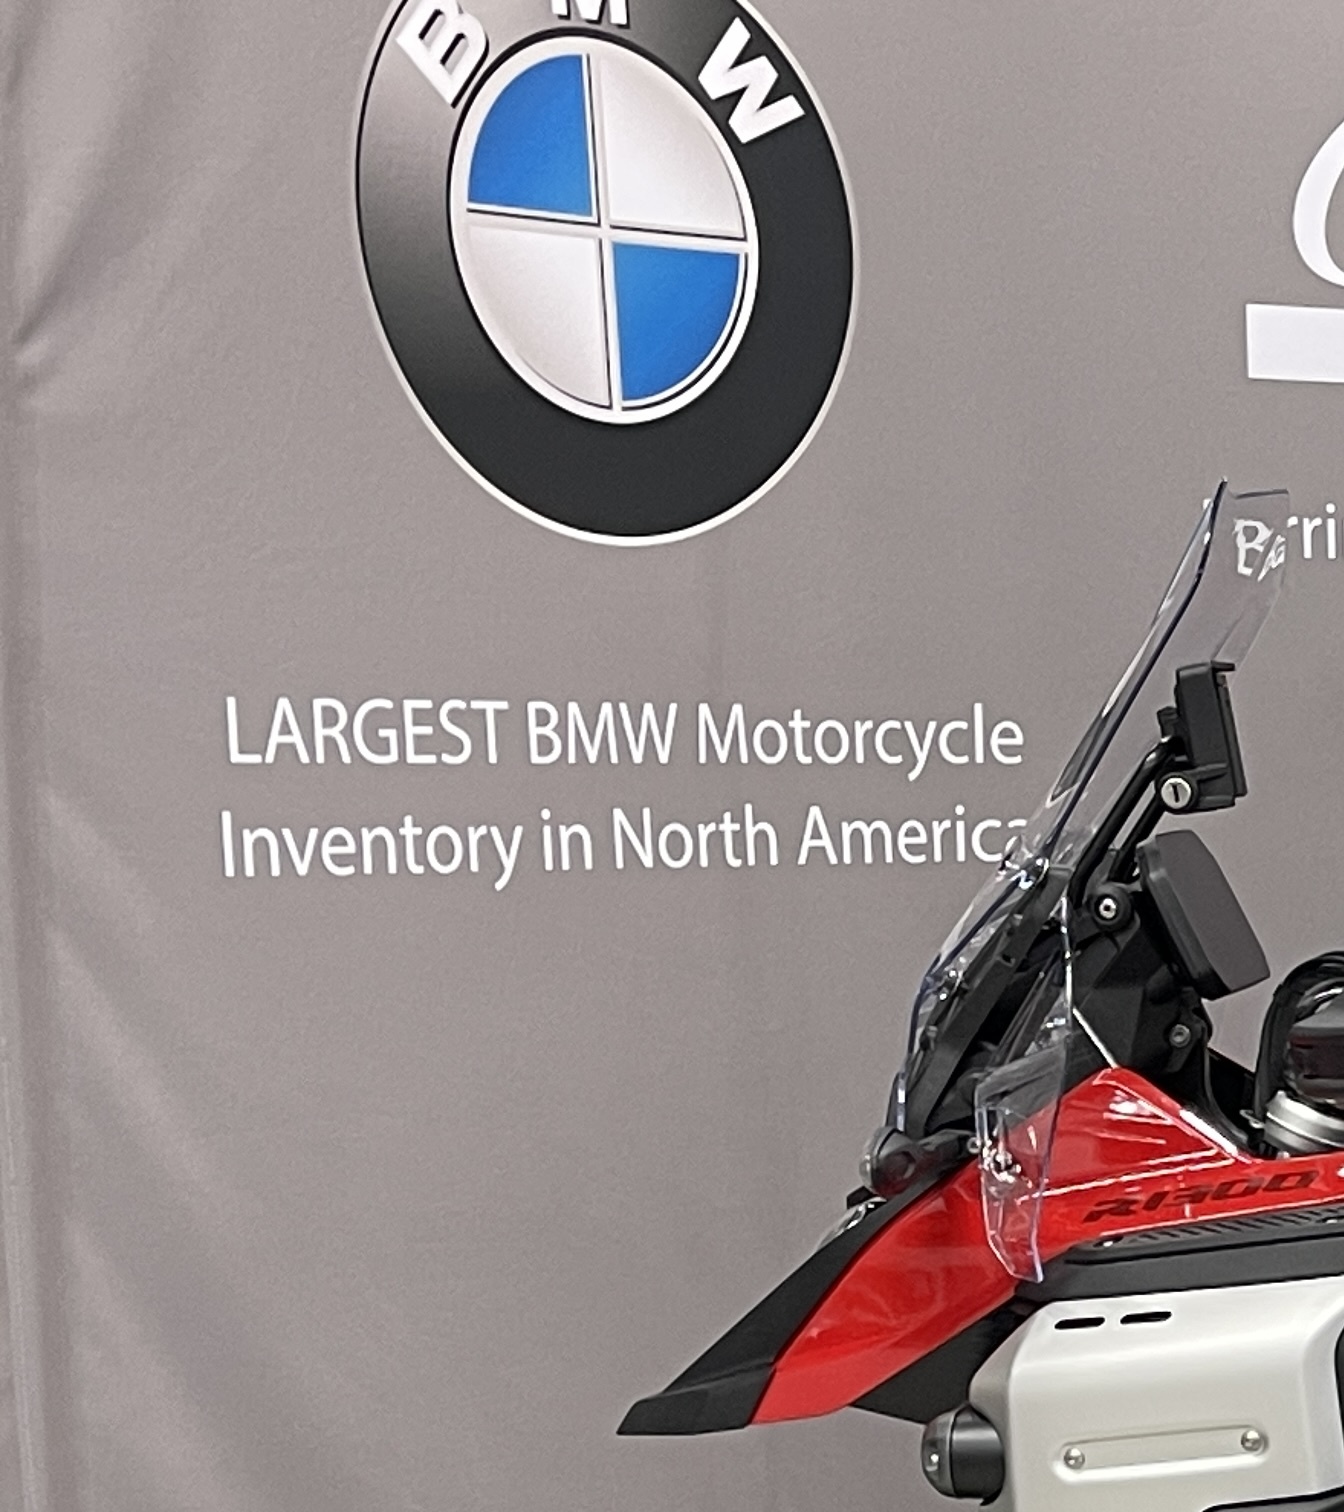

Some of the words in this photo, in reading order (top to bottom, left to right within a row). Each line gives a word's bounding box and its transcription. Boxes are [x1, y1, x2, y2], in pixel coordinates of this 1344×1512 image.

[225, 696, 509, 765] LARGEST
[527, 700, 679, 764] BMW
[698, 702, 1025, 782] Motorcycle
[220, 810, 525, 892] Inventory
[540, 808, 594, 871] in
[612, 803, 780, 869] North
